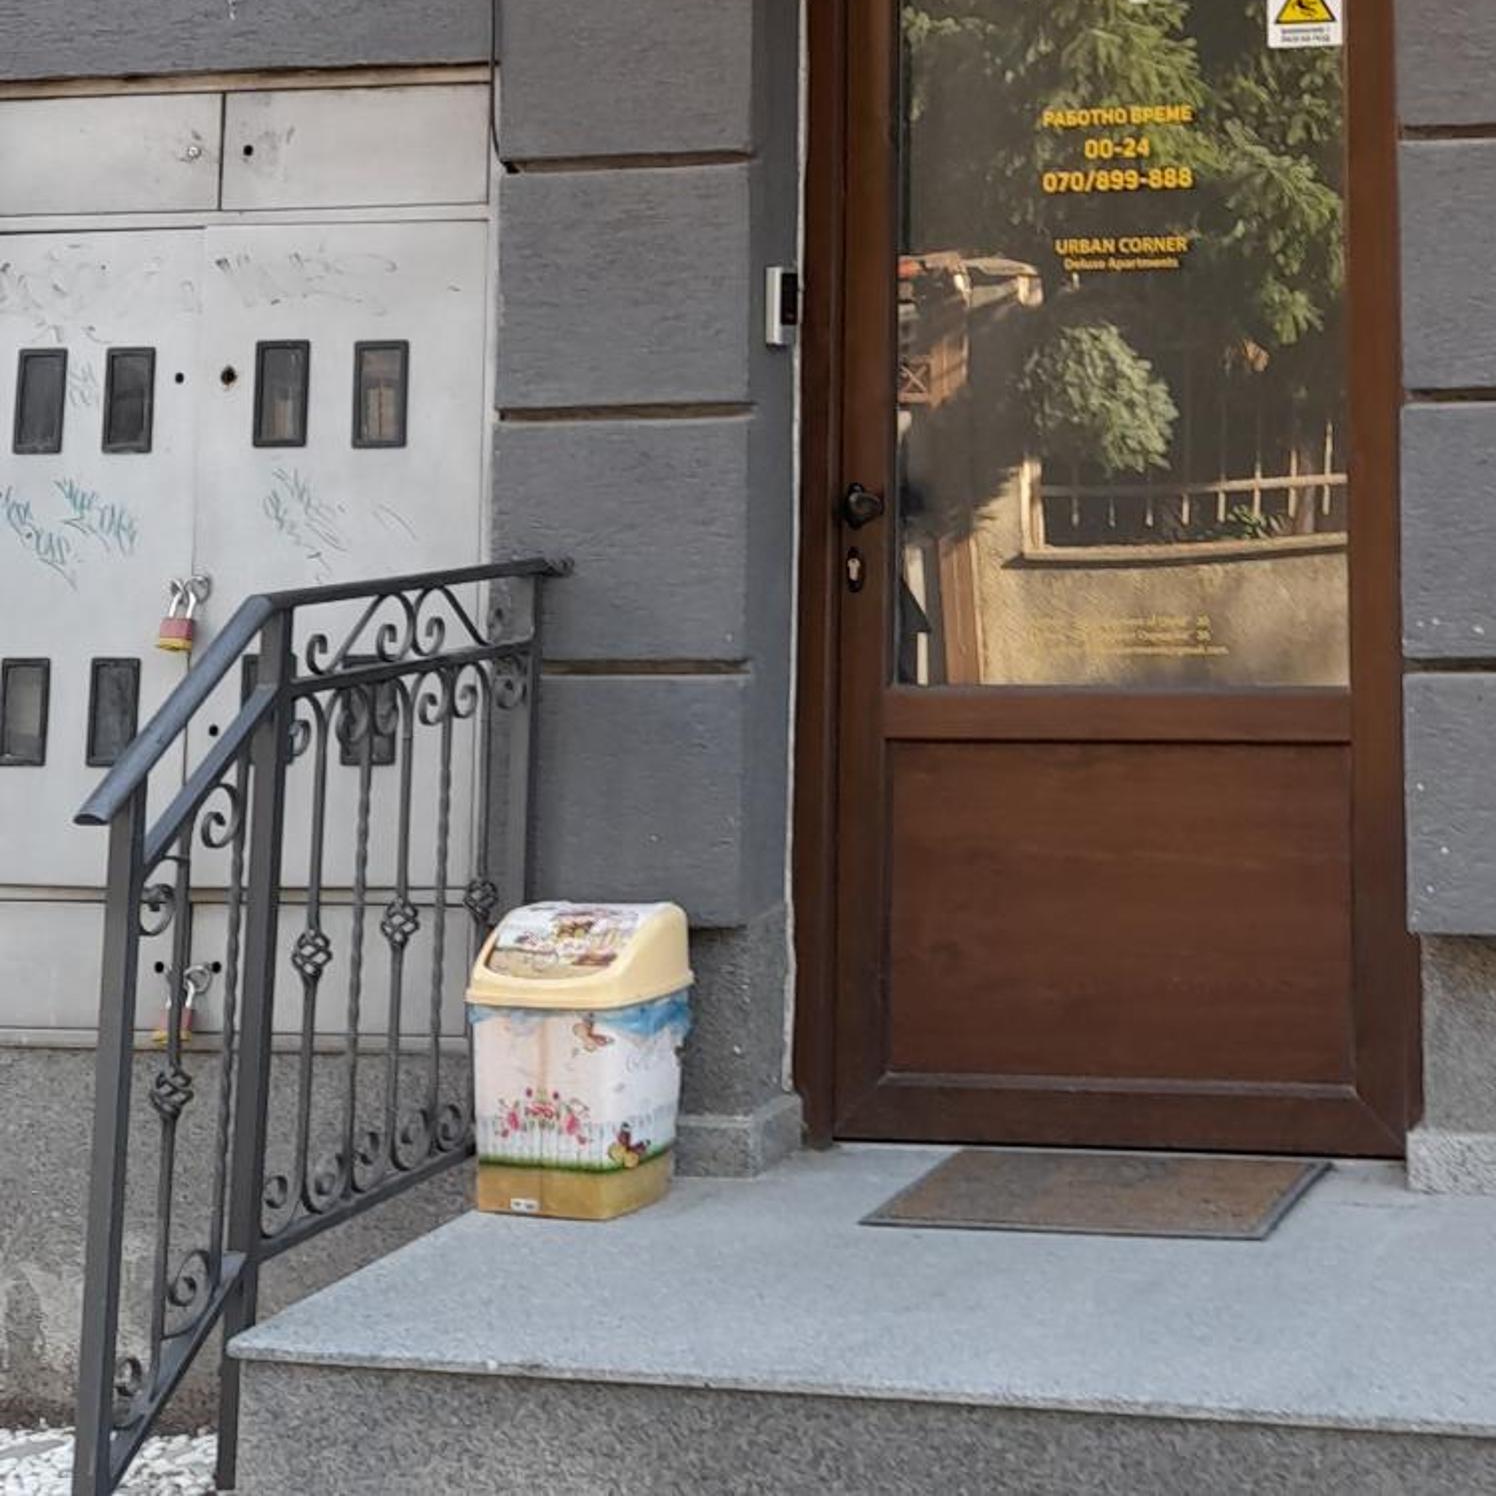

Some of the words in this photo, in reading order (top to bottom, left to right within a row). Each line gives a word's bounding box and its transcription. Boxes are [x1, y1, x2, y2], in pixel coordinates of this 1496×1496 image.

[1042, 107, 1128, 128] РАБОТНО
[1130, 104, 1194, 125] ВРЕМЕ
[1084, 137, 1151, 160] 00-24
[1042, 166, 1194, 193] 070/899-888
[1055, 237, 1116, 255] URBAN
[1118, 235, 1189, 253] CORNER
[1108, 257, 1180, 271] Apartments
